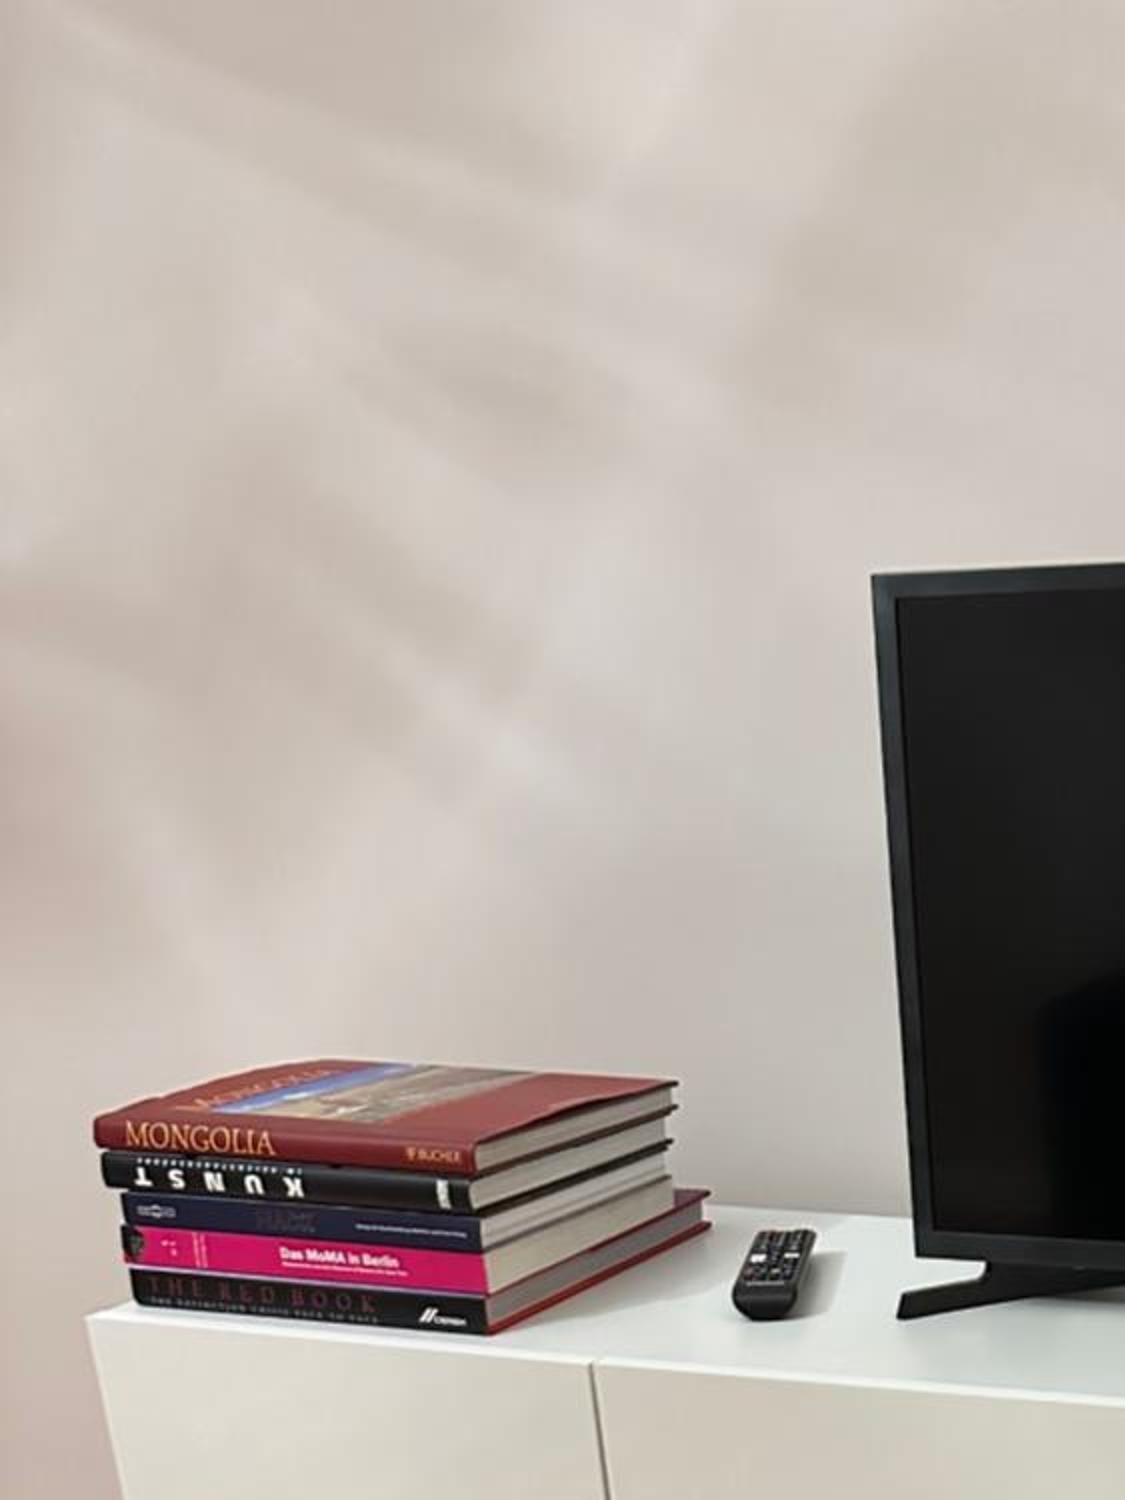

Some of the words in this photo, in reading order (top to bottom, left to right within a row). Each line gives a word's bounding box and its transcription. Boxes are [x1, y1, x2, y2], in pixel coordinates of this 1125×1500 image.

[125, 1120, 277, 1156] MONGOLIA
[134, 1166, 305, 1198] KUNST
[279, 1246, 304, 1261] Das
[305, 1248, 346, 1264] MoMA
[347, 1251, 360, 1265] in
[361, 1252, 399, 1268] Berlin
